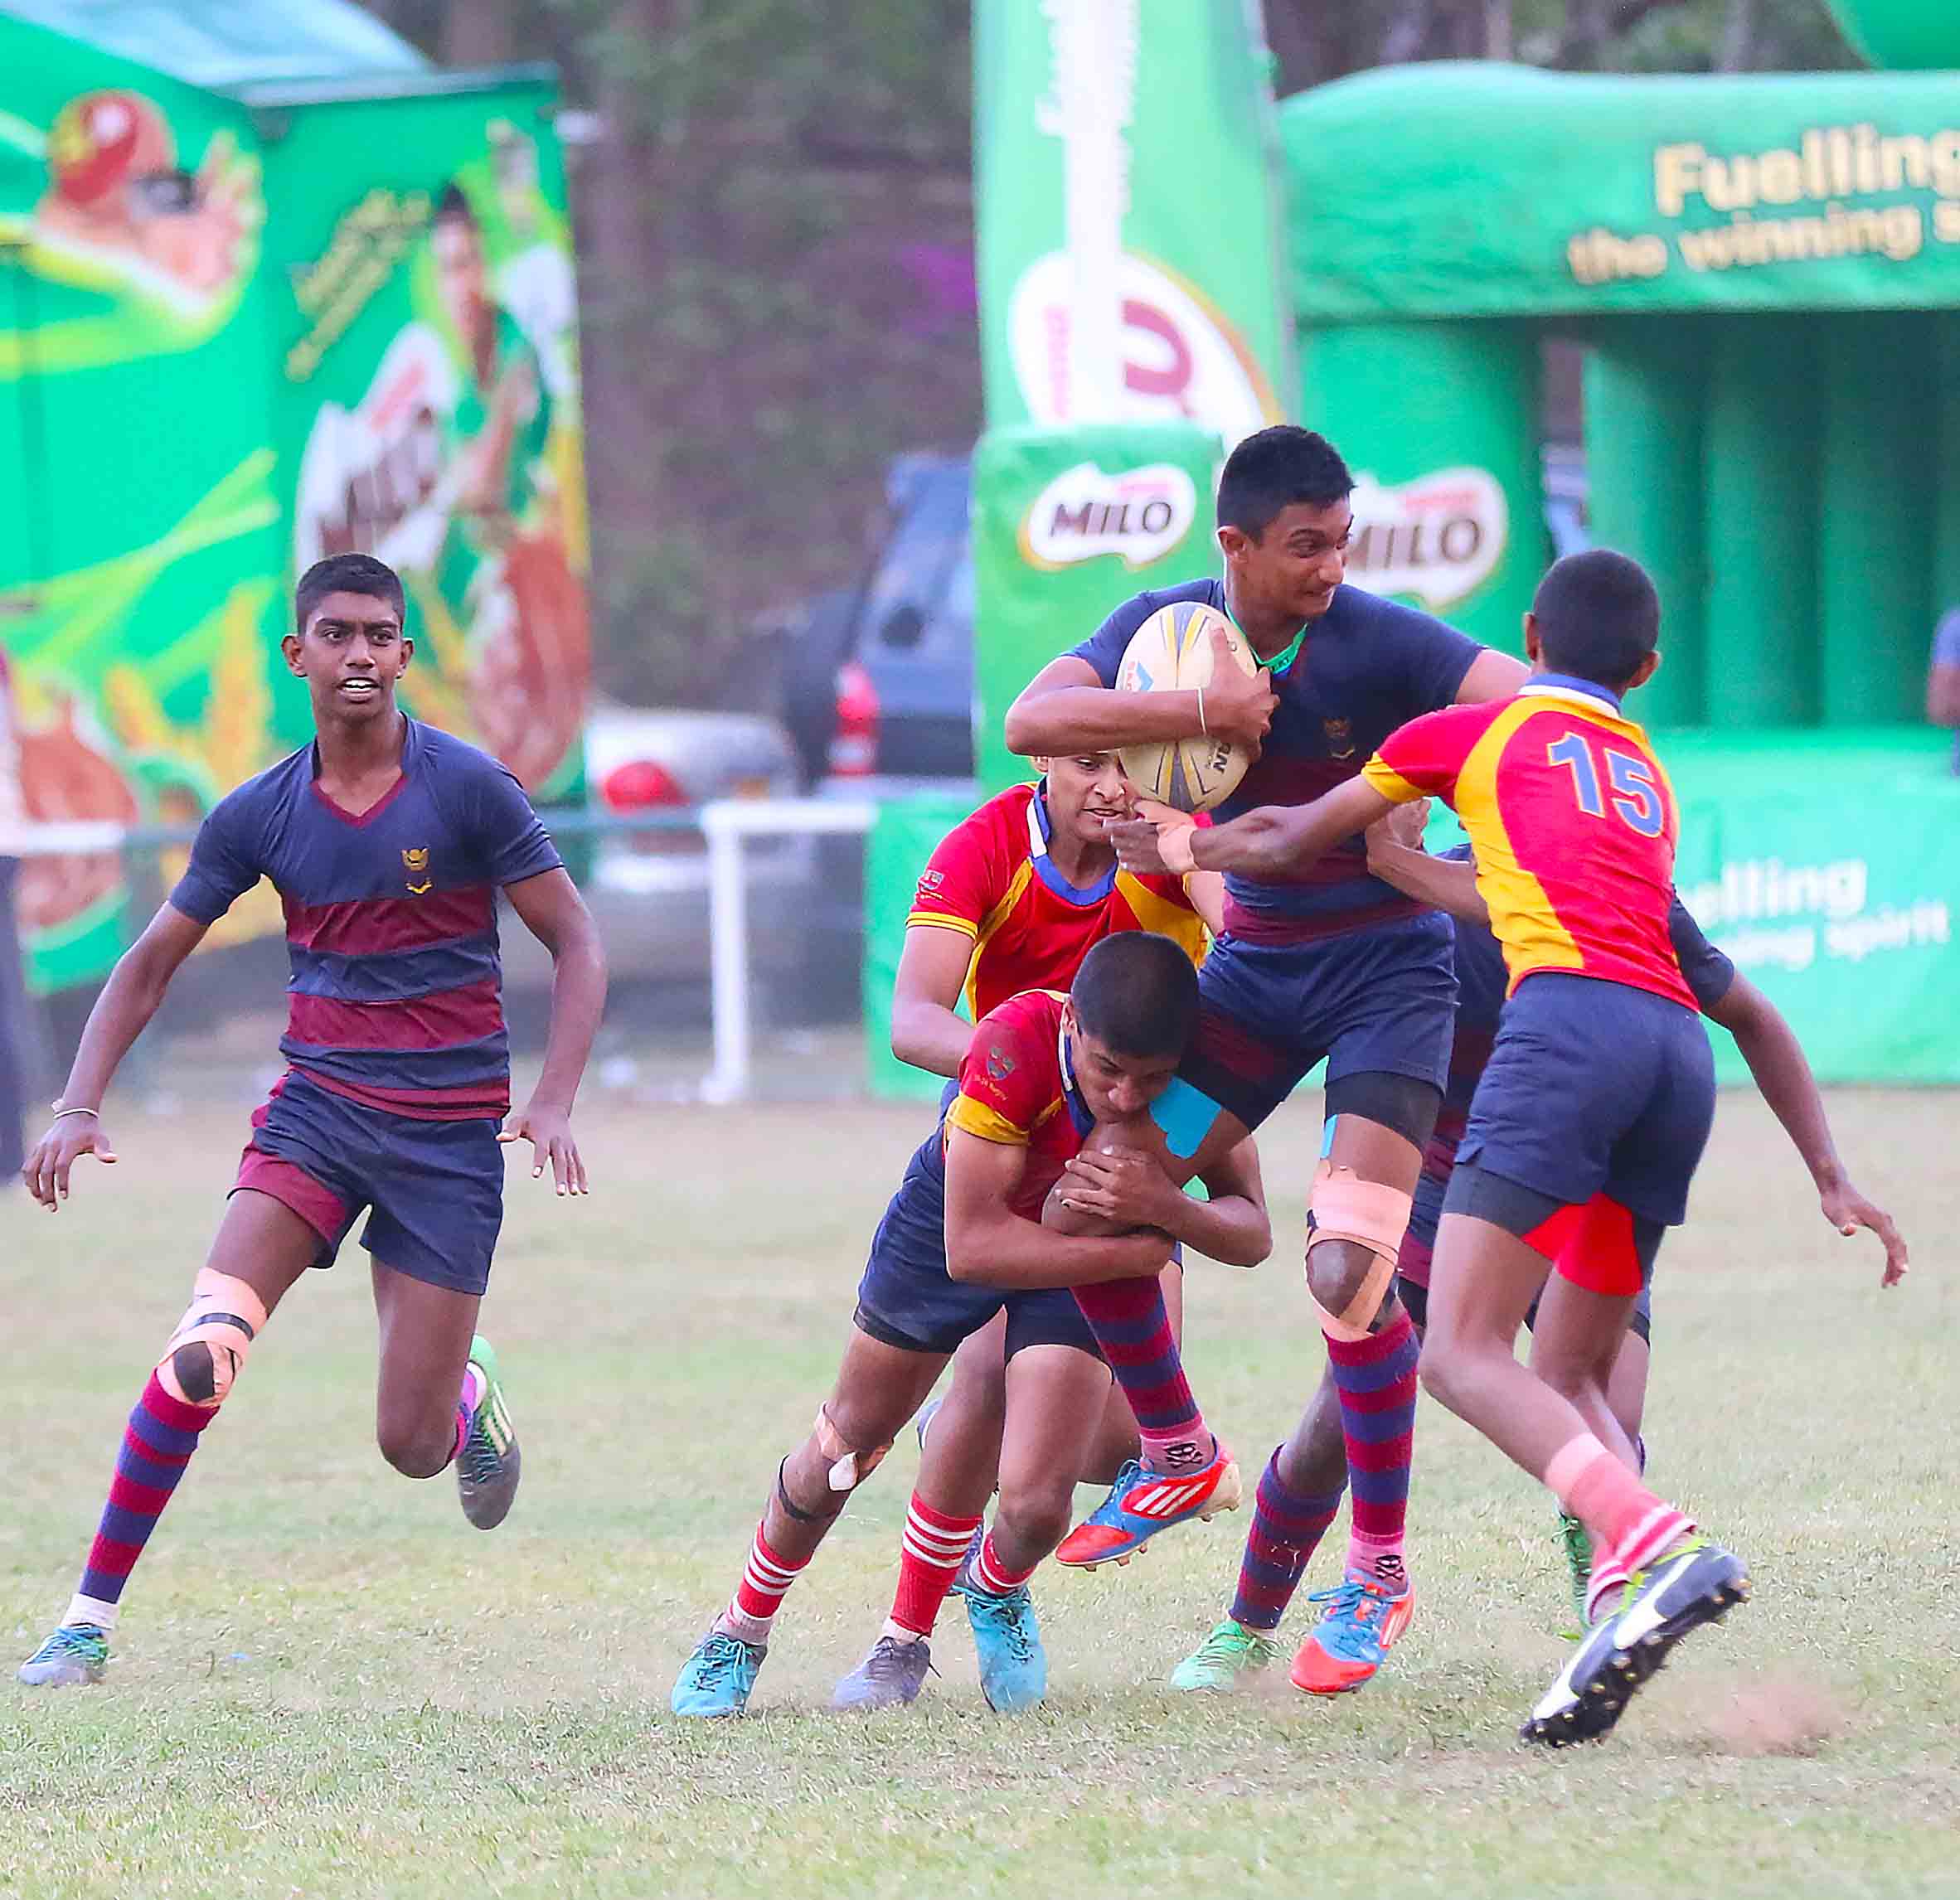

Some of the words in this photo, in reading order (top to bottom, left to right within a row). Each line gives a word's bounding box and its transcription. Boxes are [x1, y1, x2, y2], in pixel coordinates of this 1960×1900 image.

[1678, 201, 1922, 272] winning
[1050, 499, 1173, 537] MILO
[1547, 731, 1663, 839] 15
